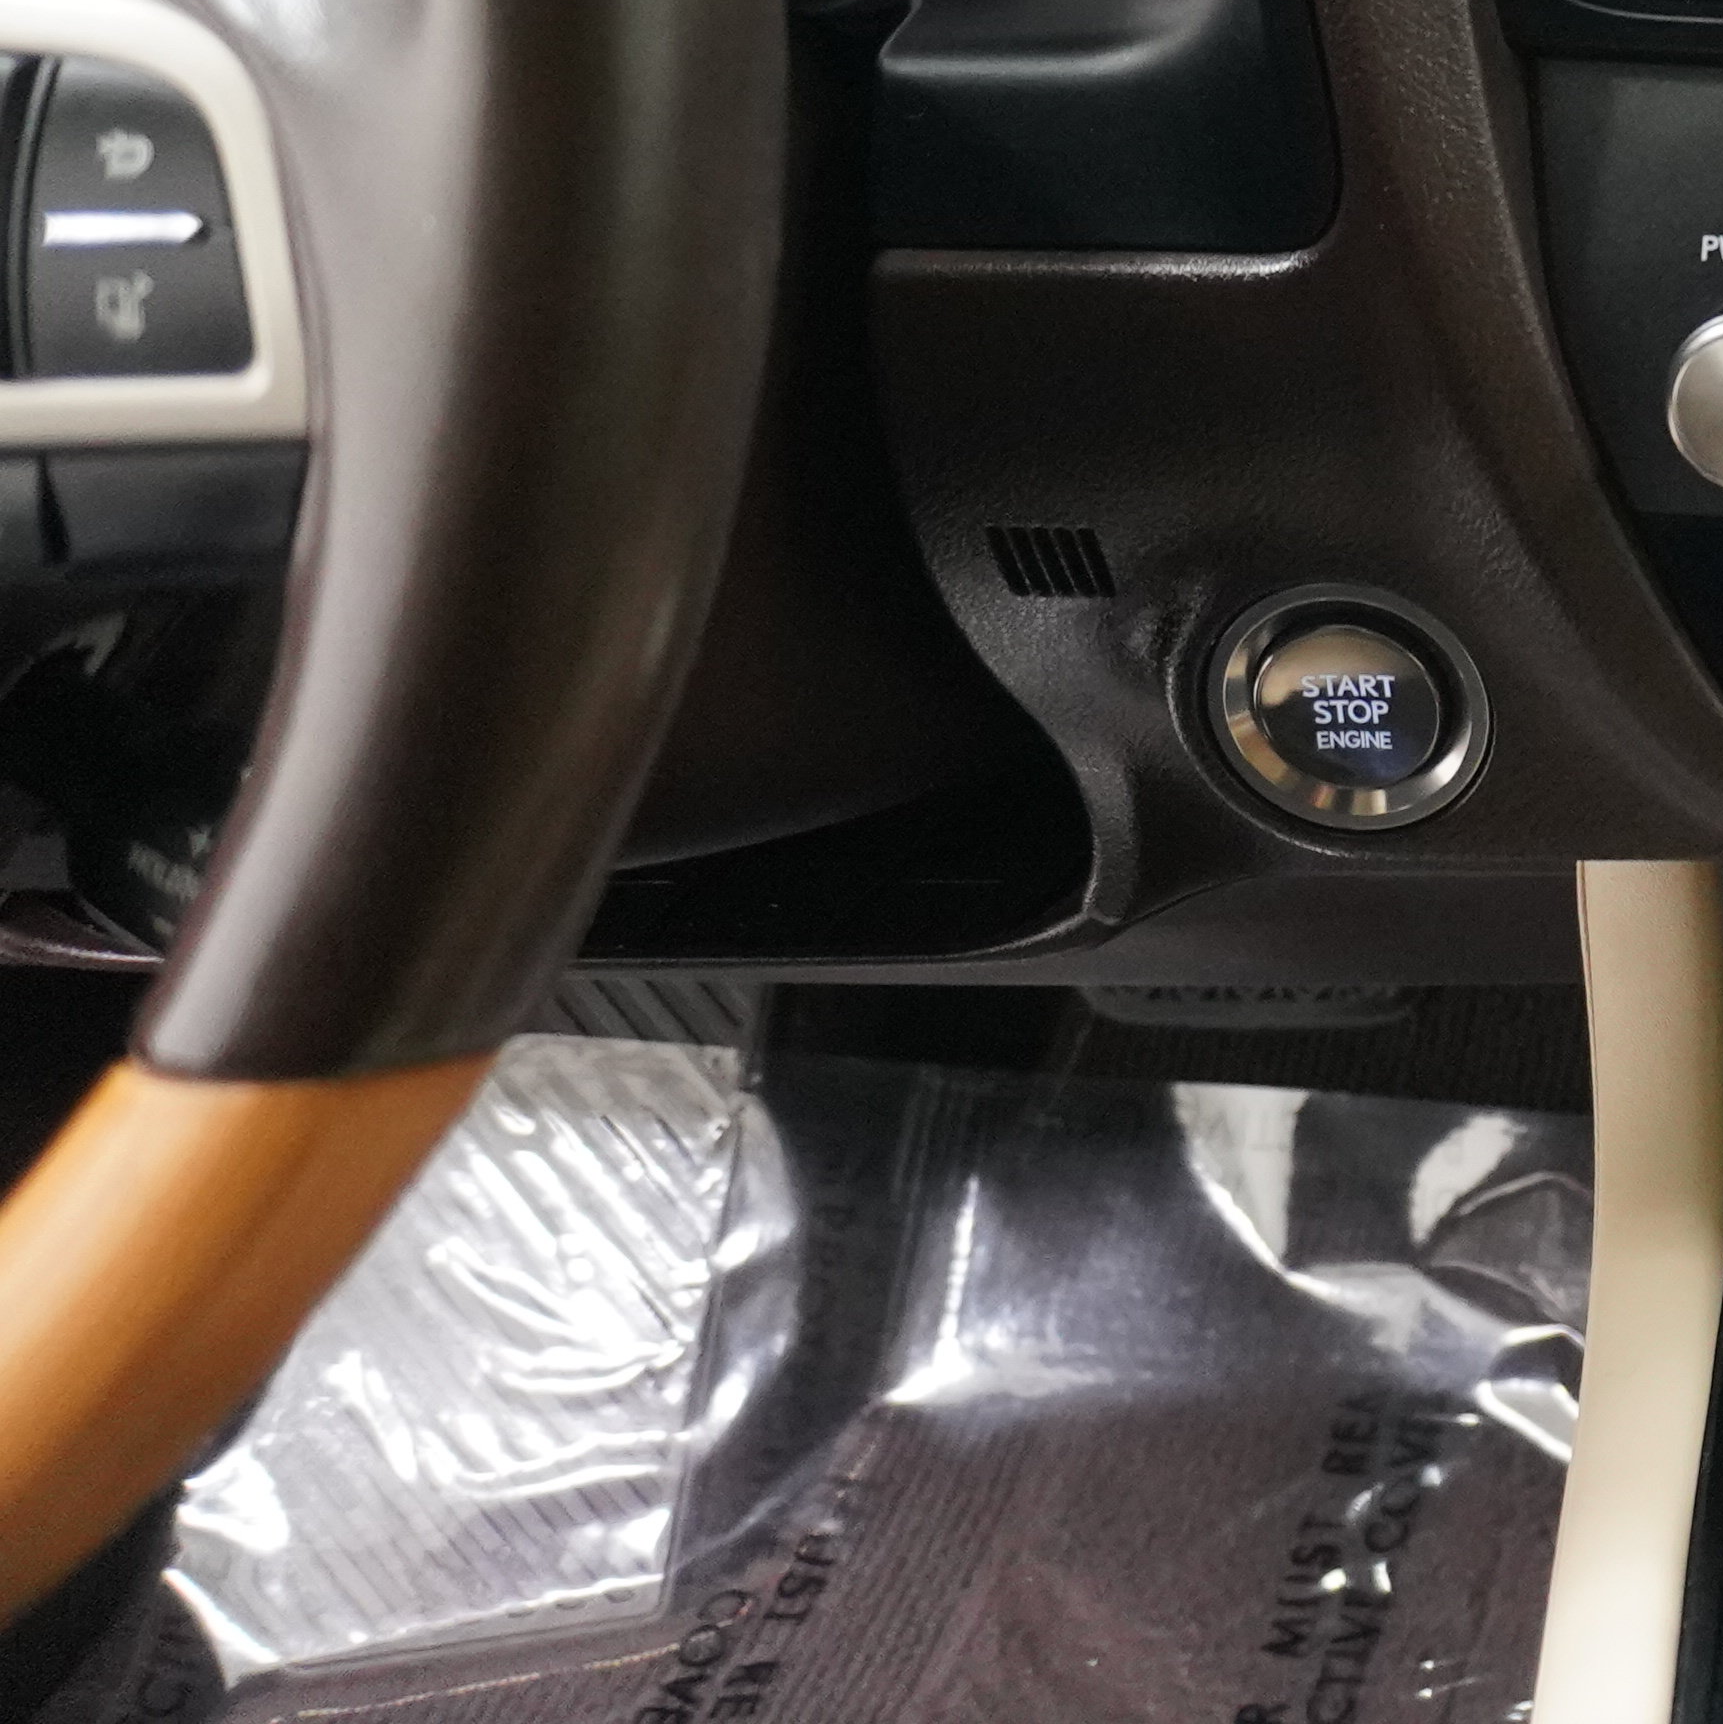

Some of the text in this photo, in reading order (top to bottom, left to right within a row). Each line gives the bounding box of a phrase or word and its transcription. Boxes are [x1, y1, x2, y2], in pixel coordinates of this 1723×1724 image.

[1300, 674, 1396, 699] START
[1312, 698, 1390, 725] STOP
[1315, 729, 1394, 751] ENGINE
